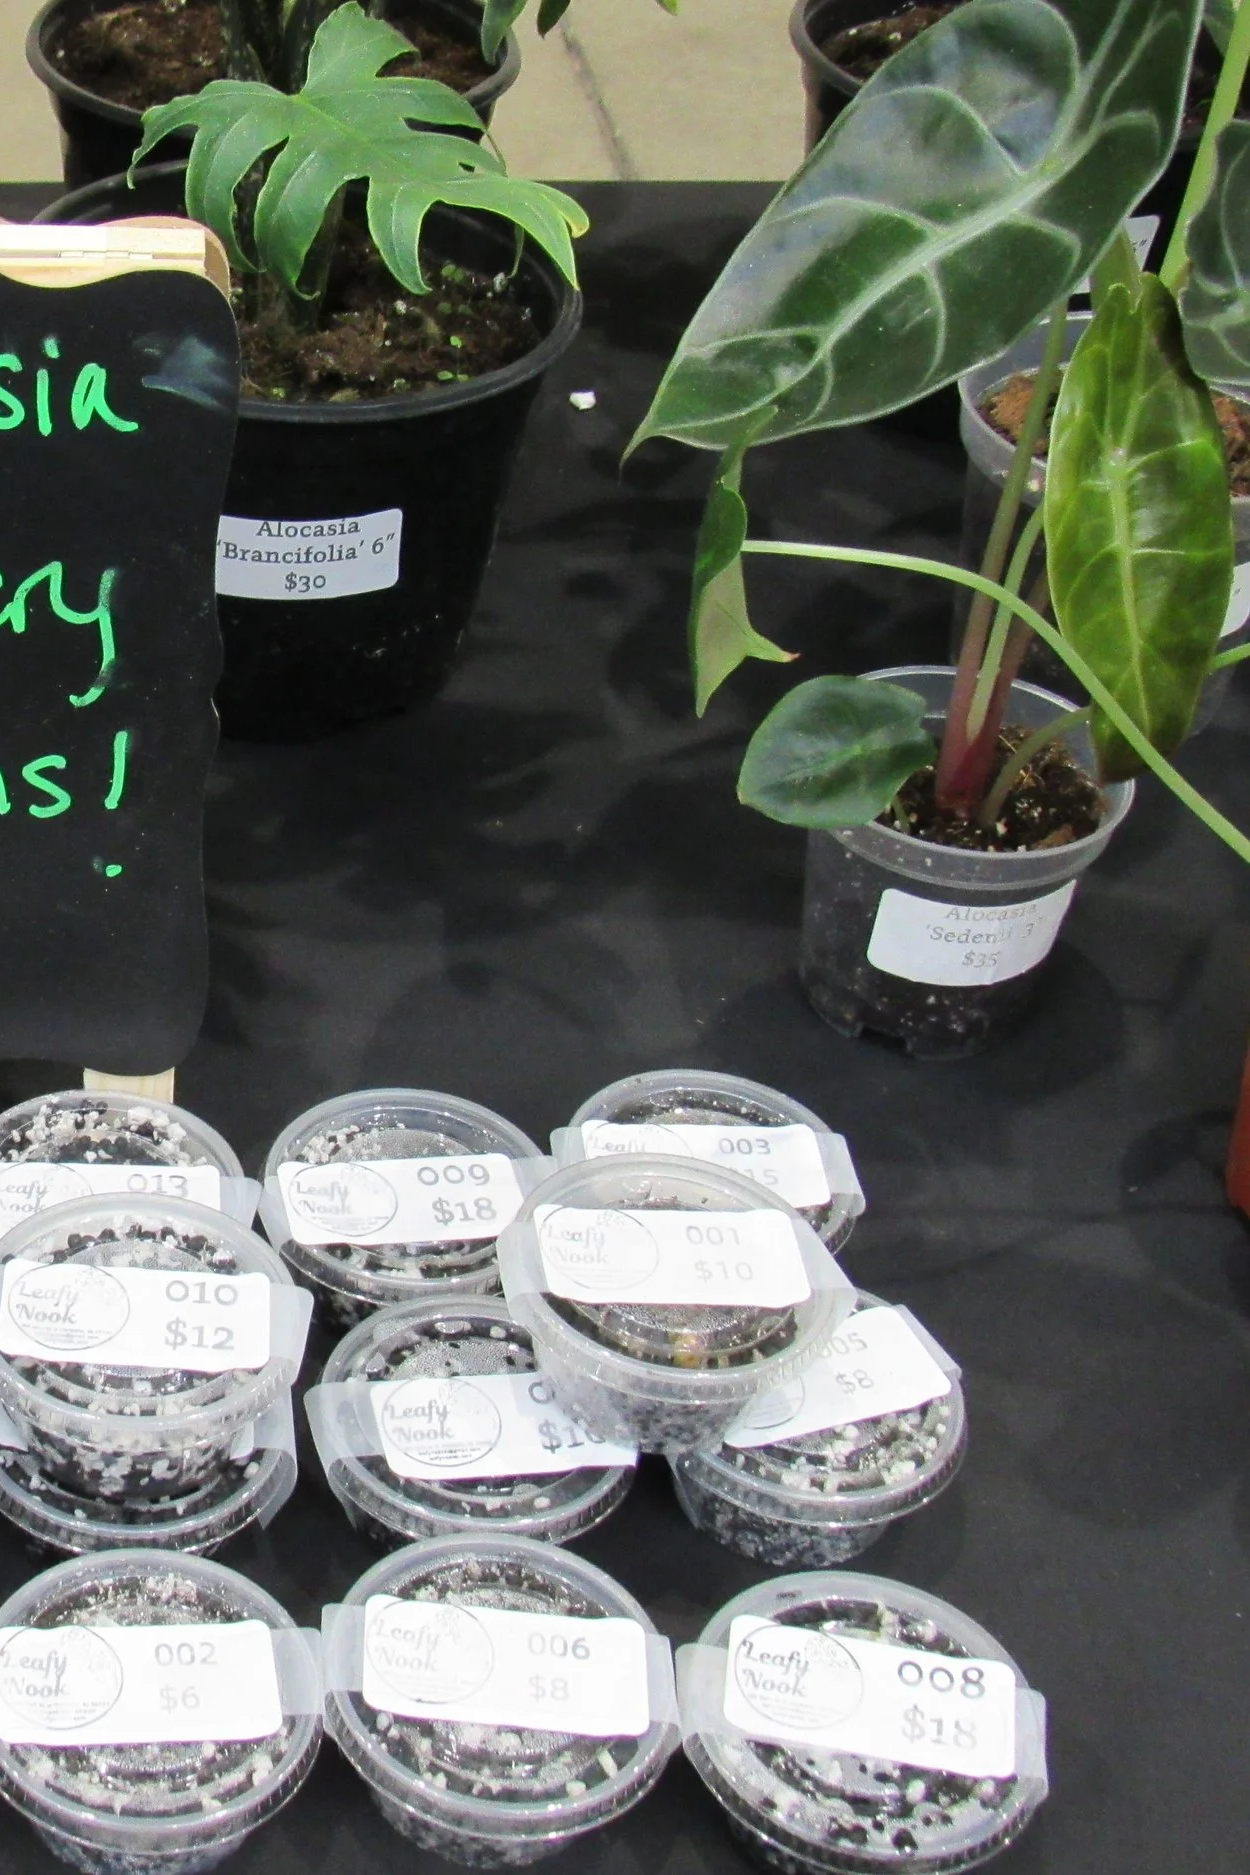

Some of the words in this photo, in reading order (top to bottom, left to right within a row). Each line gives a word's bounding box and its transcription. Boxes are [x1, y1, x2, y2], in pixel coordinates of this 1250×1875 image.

[256, 519, 361, 538] Alocasia
[284, 571, 327, 593] $30
[944, 902, 1038, 922] Alocasia
[718, 1137, 771, 1155] 003
[127, 1173, 188, 1198] 013
[417, 1163, 490, 1187] 009
[729, 1166, 779, 1187] 15
[293, 1179, 350, 1200] Leafy
[298, 1199, 353, 1215] Nook
[433, 1197, 497, 1226] $18
[544, 1225, 606, 1250] Leafy
[685, 1226, 742, 1247] 001
[550, 1247, 610, 1266] Nook
[694, 1261, 754, 1284] $10
[14, 1280, 80, 1306] Leafy
[165, 1279, 238, 1305] 010
[16, 1303, 76, 1324] Nook
[164, 1316, 235, 1350] $12
[835, 1368, 876, 1396] $8
[385, 1399, 451, 1426] Leafy
[391, 1421, 455, 1444] Nook
[374, 1618, 440, 1649] Leafy
[154, 1641, 218, 1666] 002
[375, 1644, 438, 1673] Nook
[528, 1632, 591, 1661] 006
[741, 1638, 810, 1679] Leafy
[0, 1648, 67, 1681] Leafy
[3, 1674, 70, 1698] Nook
[528, 1673, 570, 1703] $8
[742, 1668, 807, 1699] Nook
[898, 1660, 986, 1699] 008
[159, 1684, 202, 1714] $6
[901, 1703, 979, 1750] $18
